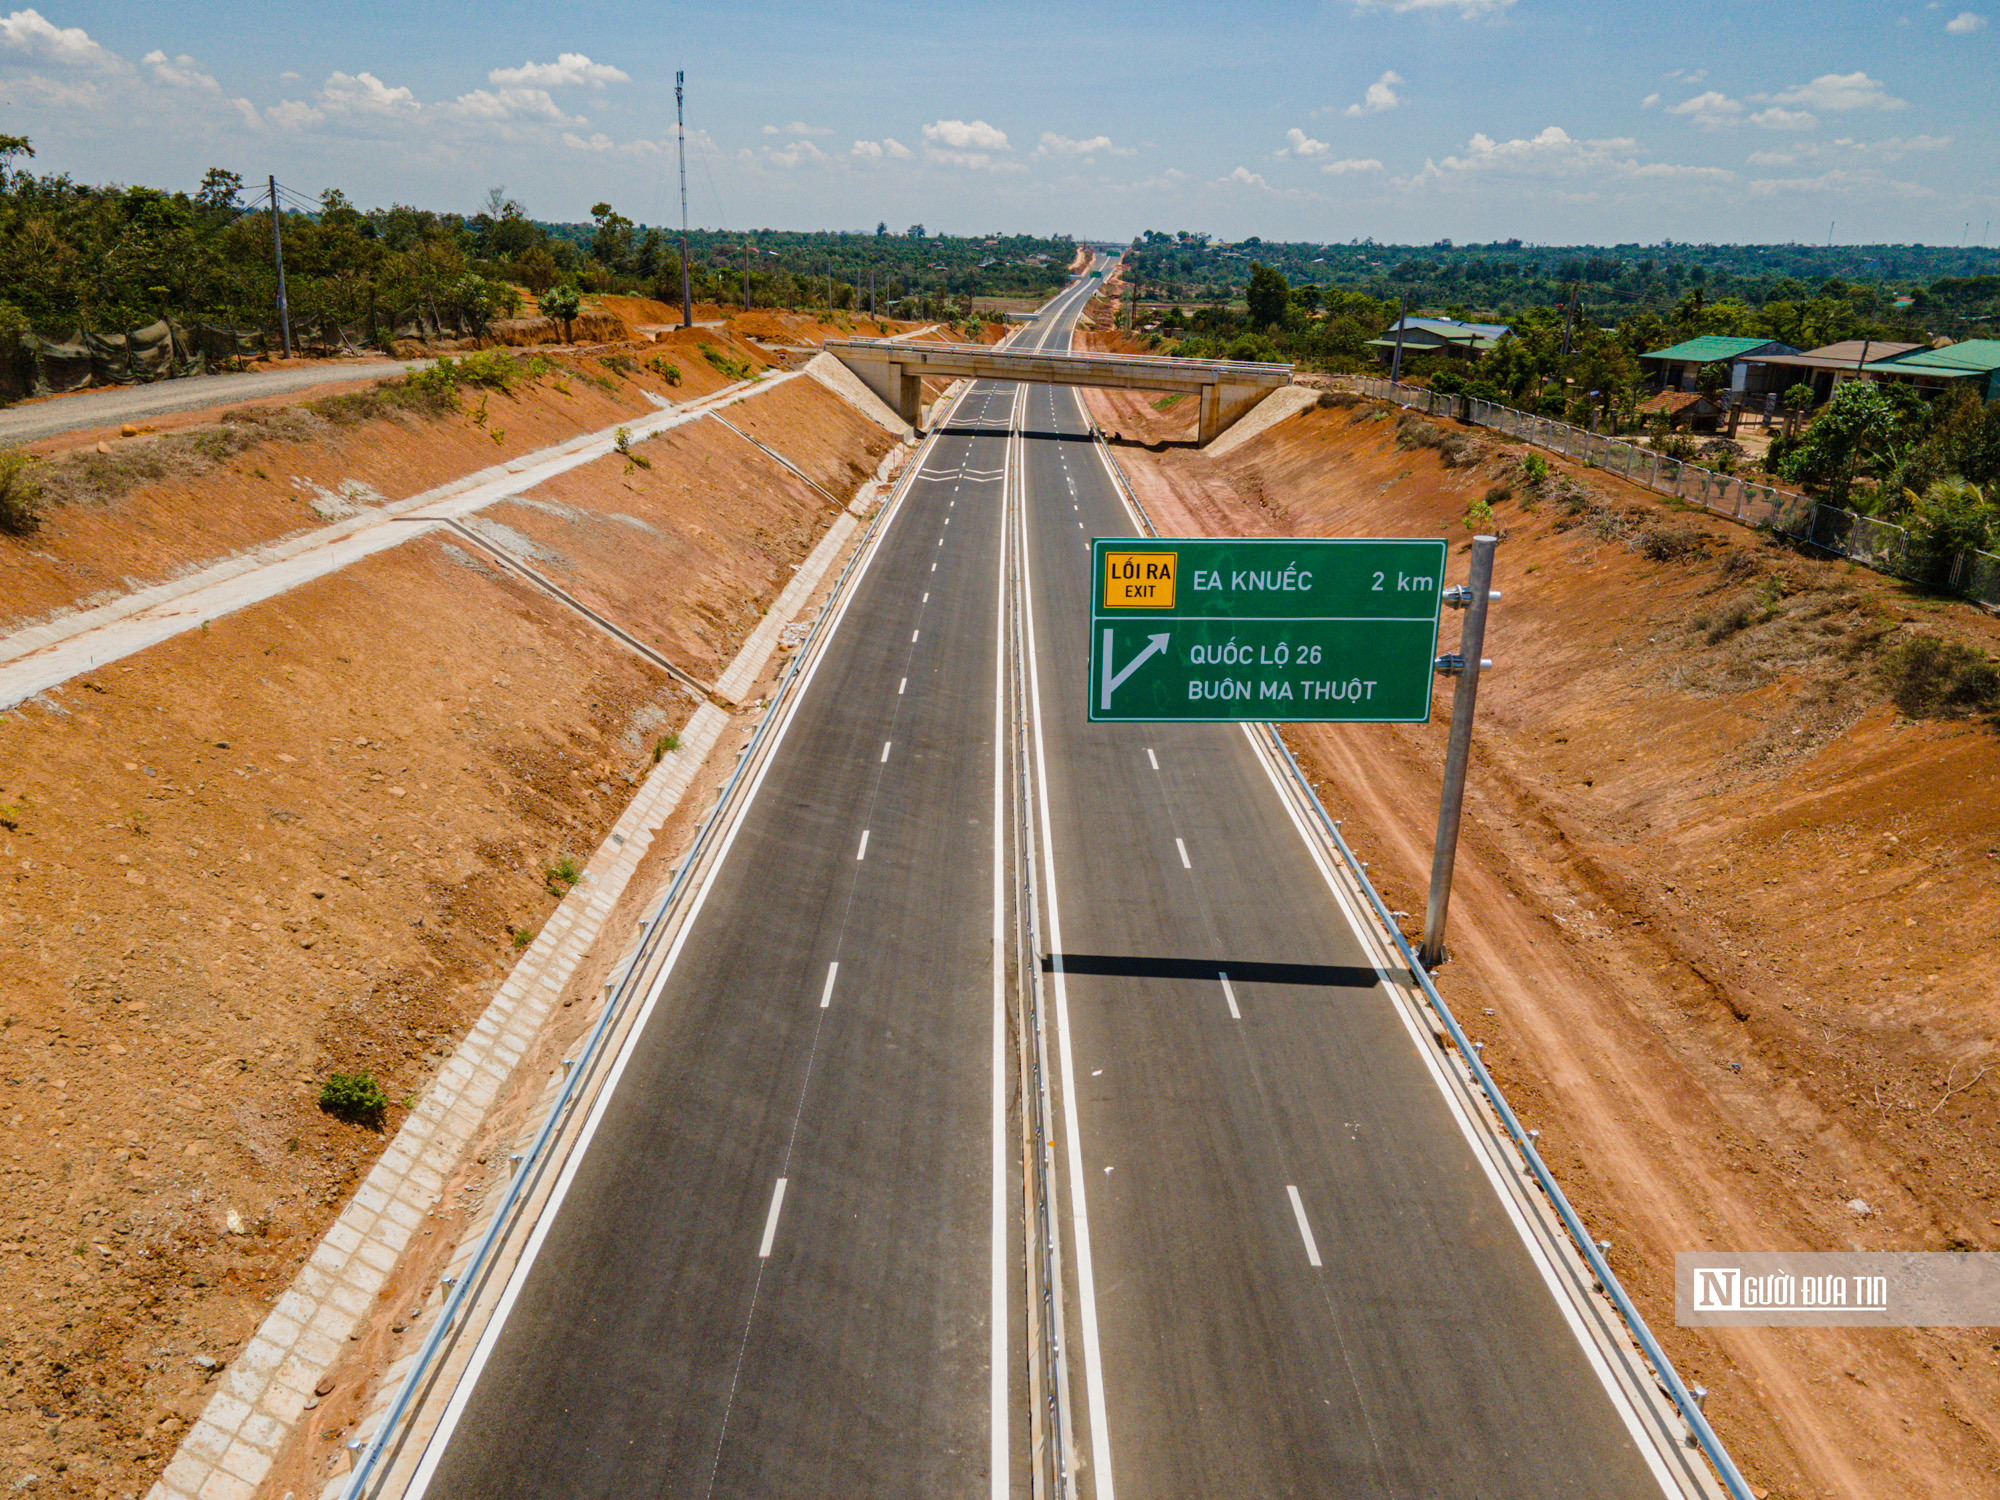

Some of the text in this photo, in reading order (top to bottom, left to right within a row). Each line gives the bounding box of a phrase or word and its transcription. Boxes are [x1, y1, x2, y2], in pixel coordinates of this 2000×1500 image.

[1112, 556, 1171, 580] LỐI RA
[1193, 560, 1313, 591] EA KNUẾC
[1125, 585, 1156, 598] EXIT
[1371, 571, 1434, 591] 2 km
[1190, 636, 1322, 669] QUỐC LỘ 26
[1188, 677, 1378, 704] BUÔN MA THUỘT
